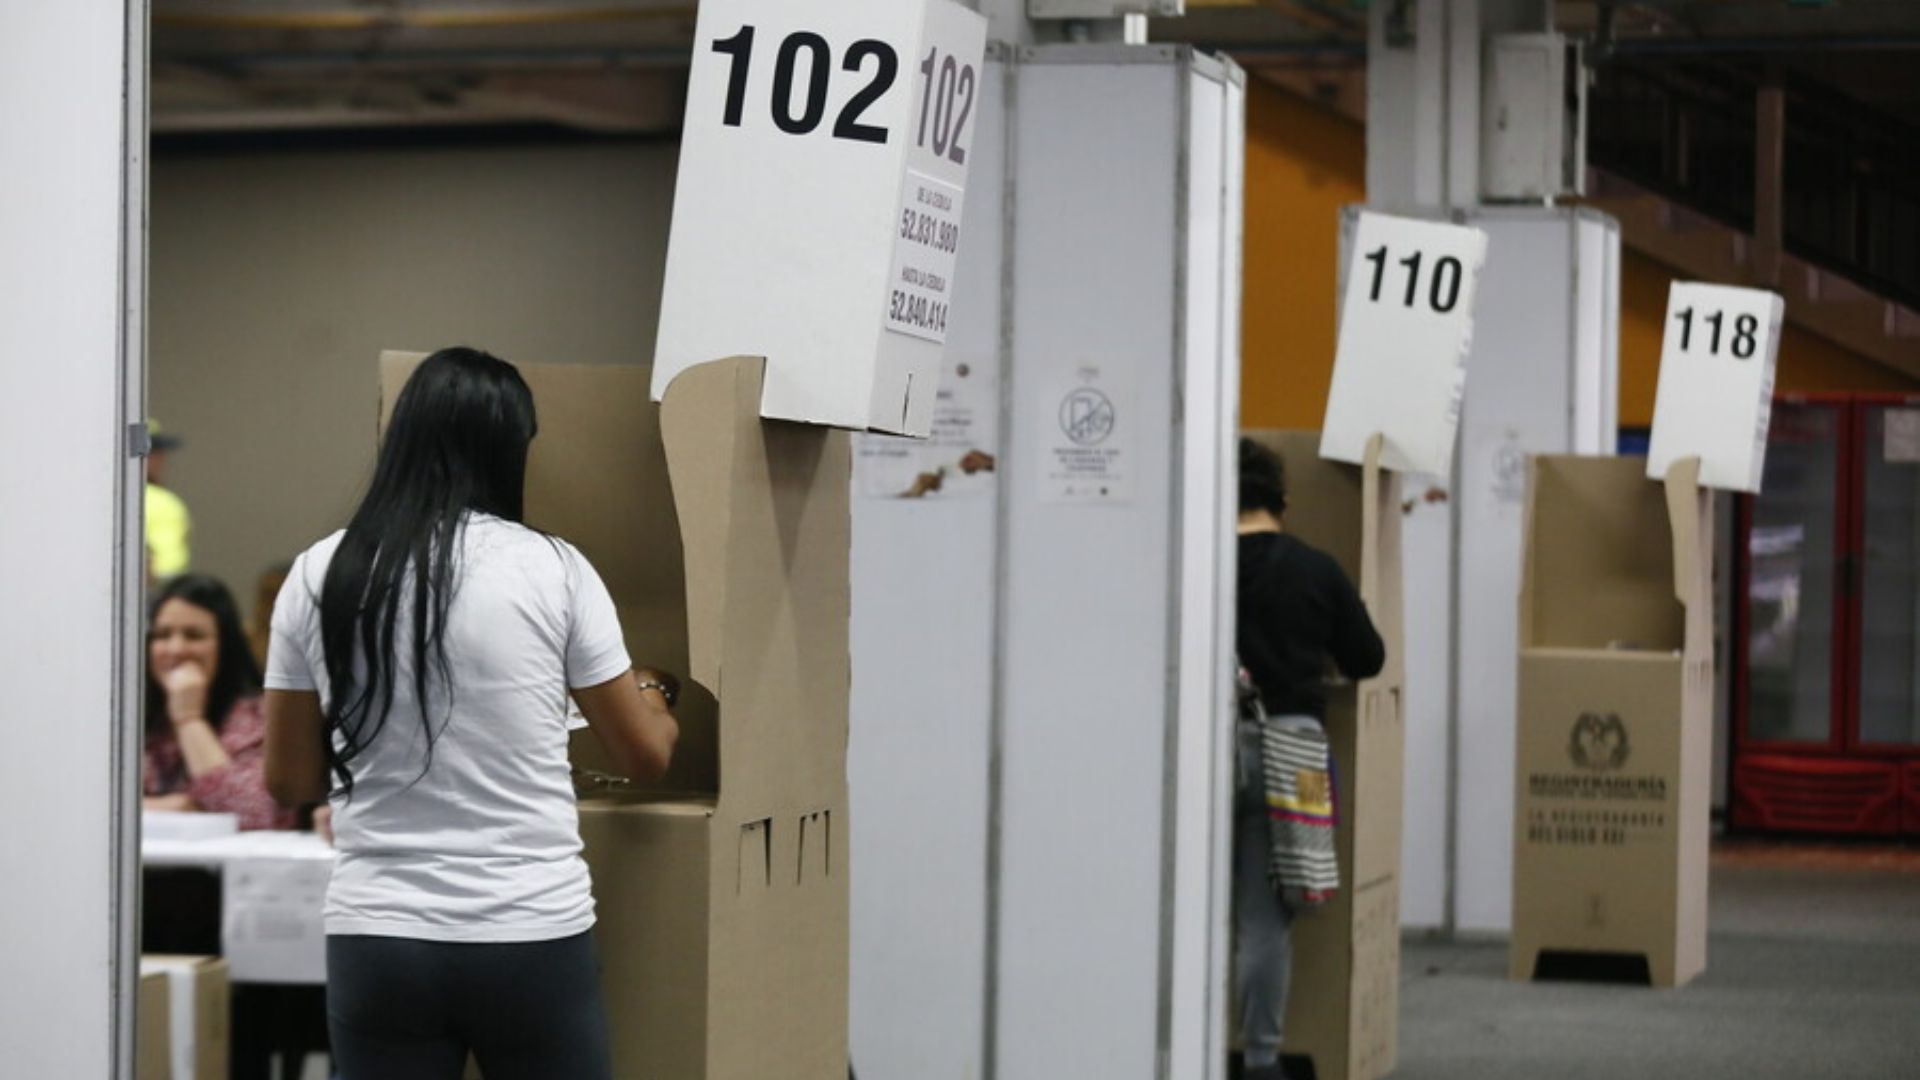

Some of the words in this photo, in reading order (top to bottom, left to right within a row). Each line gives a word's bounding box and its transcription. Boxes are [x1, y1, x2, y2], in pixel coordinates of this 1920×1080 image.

[711, 25, 900, 144] 102
[916, 45, 977, 166] 102
[1365, 245, 1462, 313] 110
[1676, 307, 1759, 359] 118
